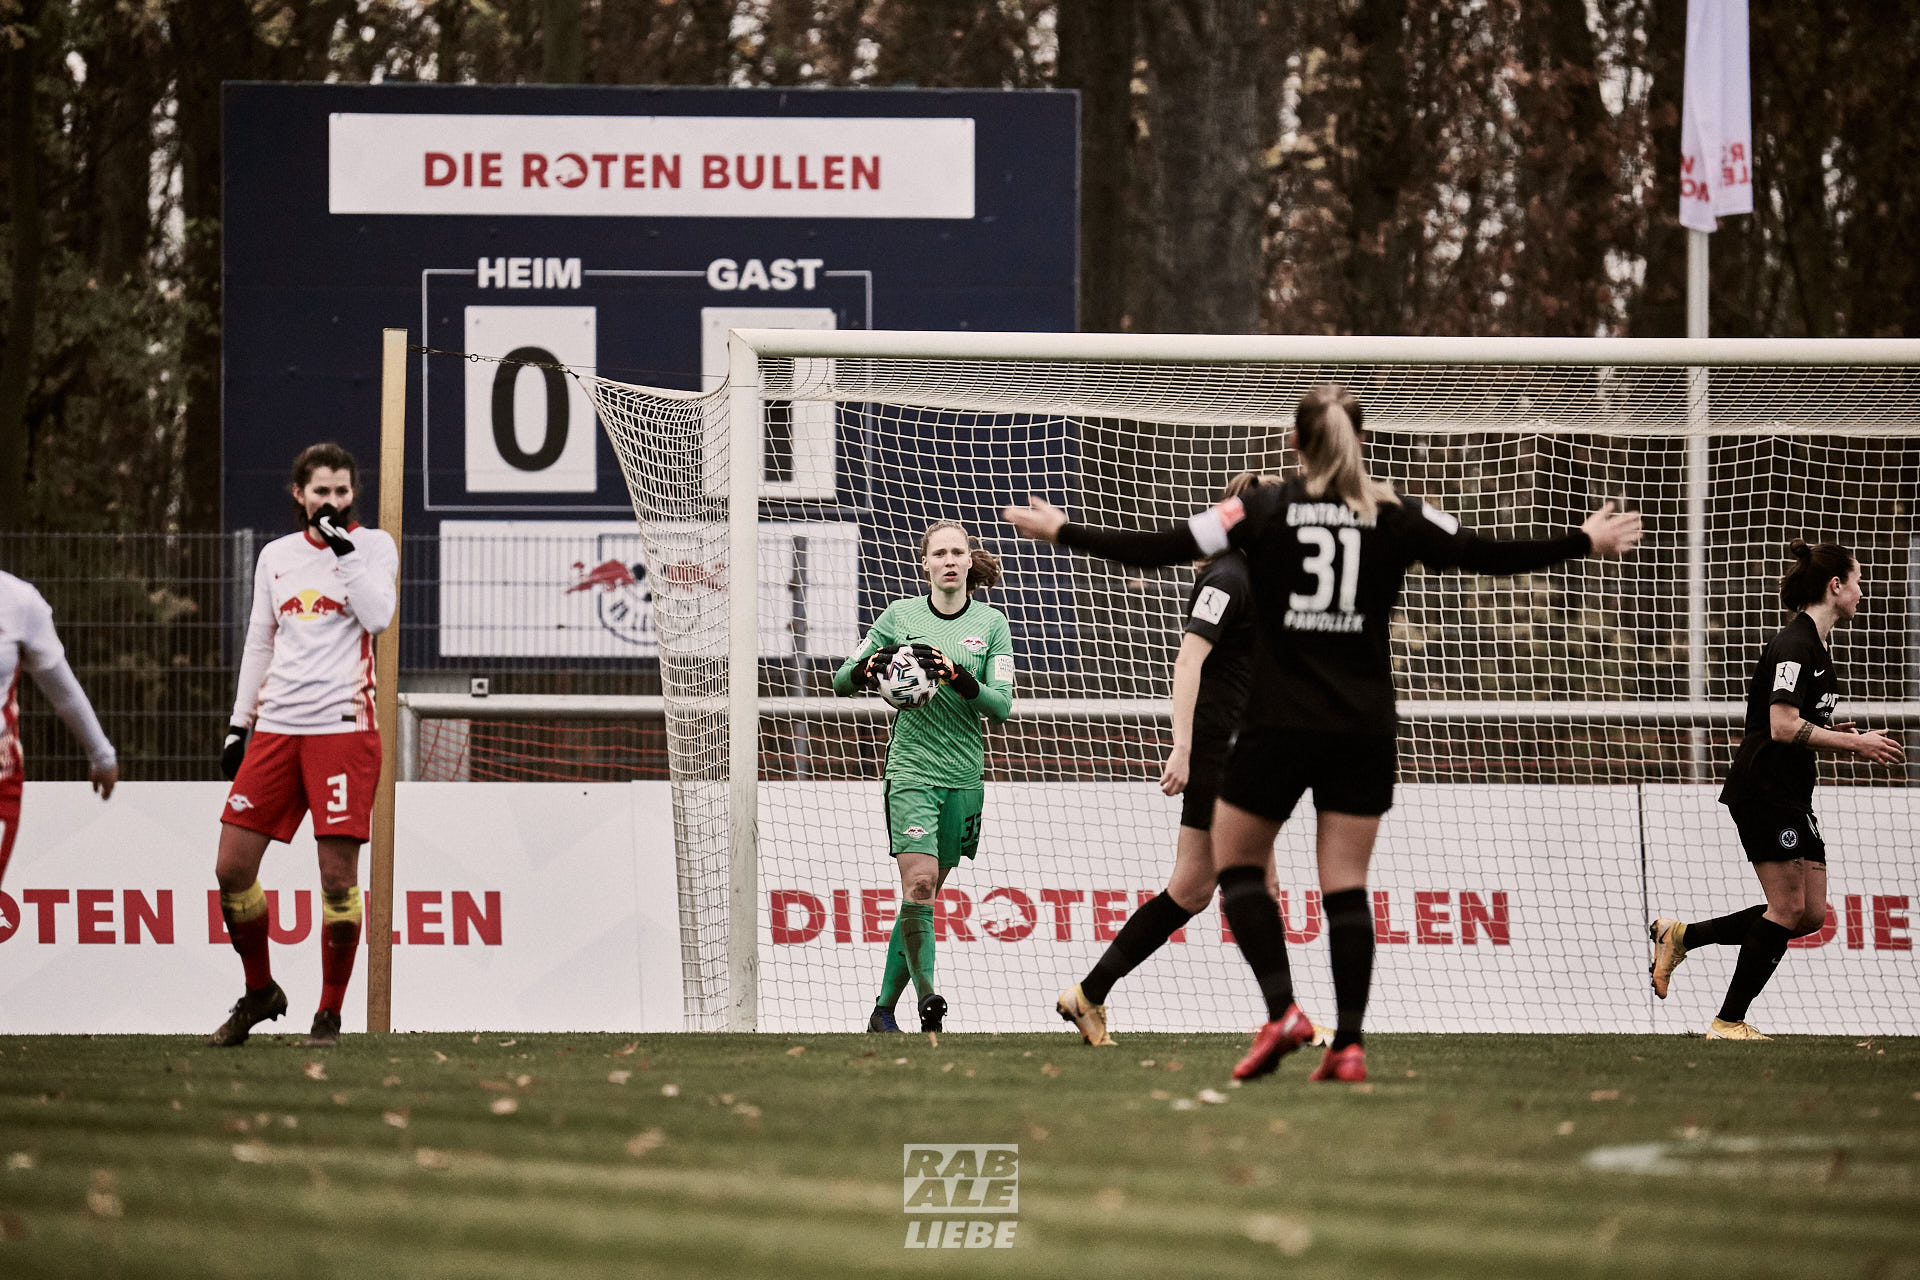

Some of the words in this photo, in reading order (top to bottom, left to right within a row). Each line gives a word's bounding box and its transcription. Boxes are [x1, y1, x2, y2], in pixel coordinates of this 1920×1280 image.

[424, 152, 503, 187] DIE
[522, 153, 681, 188] ROTEN
[703, 154, 880, 190] BULLEN
[478, 257, 582, 289] HEIM
[706, 258, 823, 291] GAST
[492, 346, 569, 472] 0
[1286, 503, 1377, 528] EINTRAC
[1289, 526, 1361, 612] 31
[327, 773, 347, 812] 3
[207, 890, 502, 945] UEN
[770, 889, 895, 944] DIE
[1219, 890, 1511, 945] ULEN
